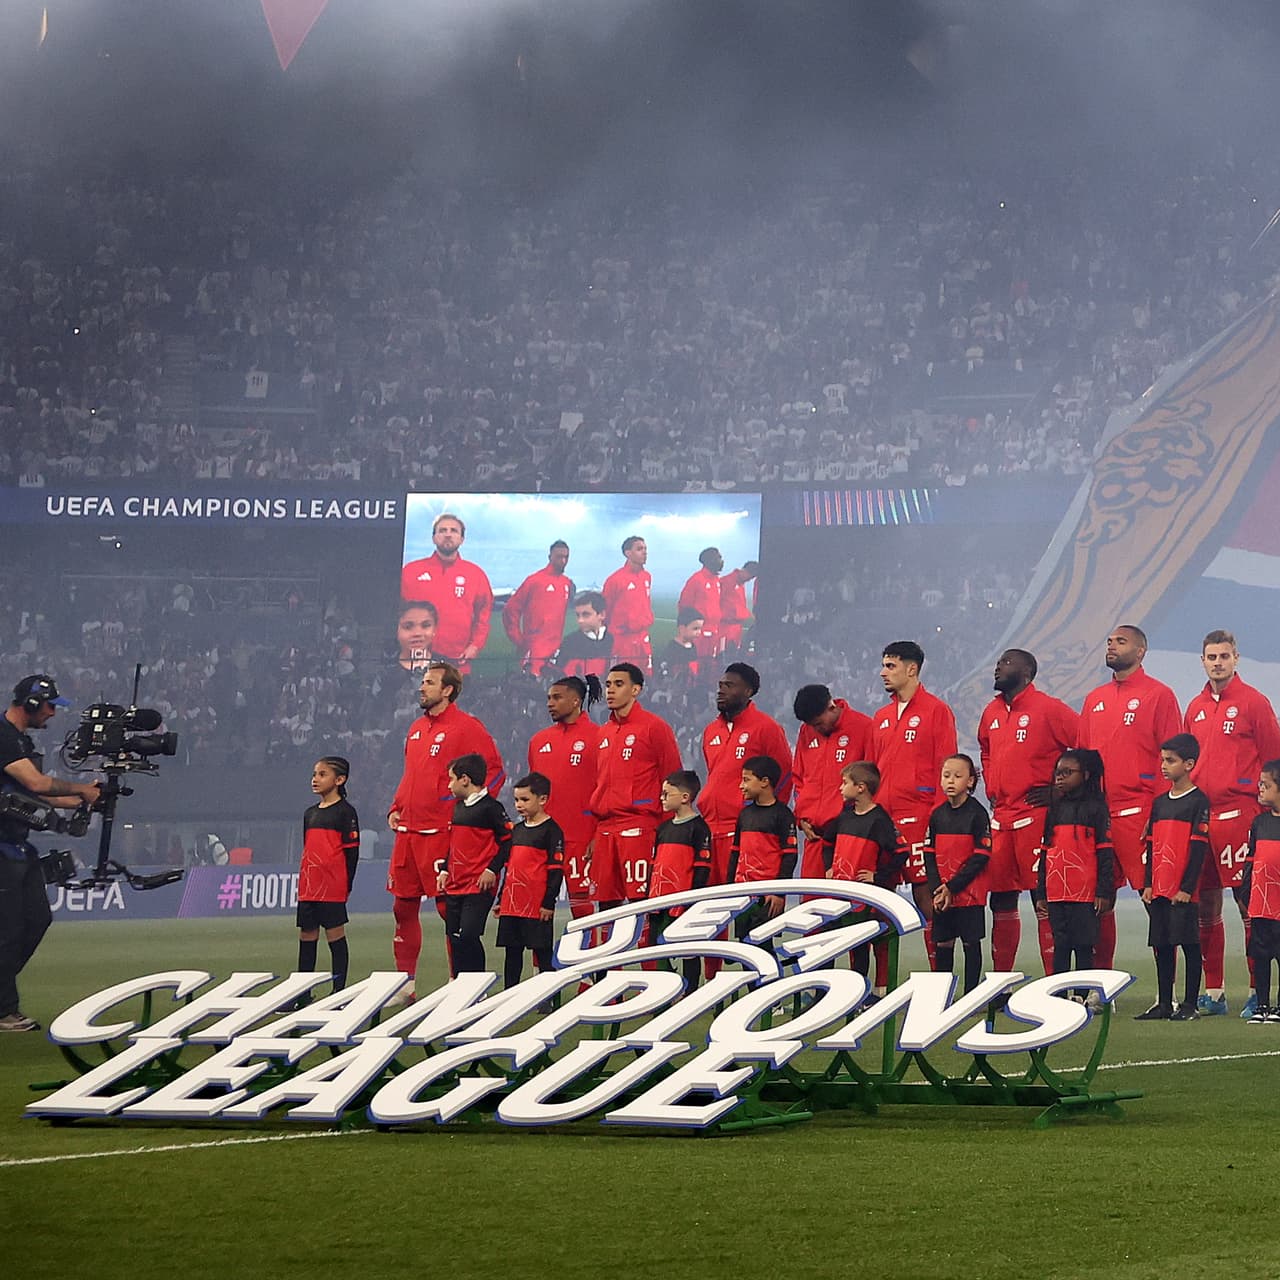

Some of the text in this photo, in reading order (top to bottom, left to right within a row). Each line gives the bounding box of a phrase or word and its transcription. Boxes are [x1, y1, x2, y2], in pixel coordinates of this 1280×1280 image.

[45, 495, 397, 520] UEFA CHAMPIONS LEAGUE
[625, 859, 647, 882] 10
[1220, 843, 1249, 868] 44
[555, 894, 888, 974] UEFA
[48, 968, 1136, 1053] CHAMPIONS
[22, 1036, 806, 1127] LEAGUE
